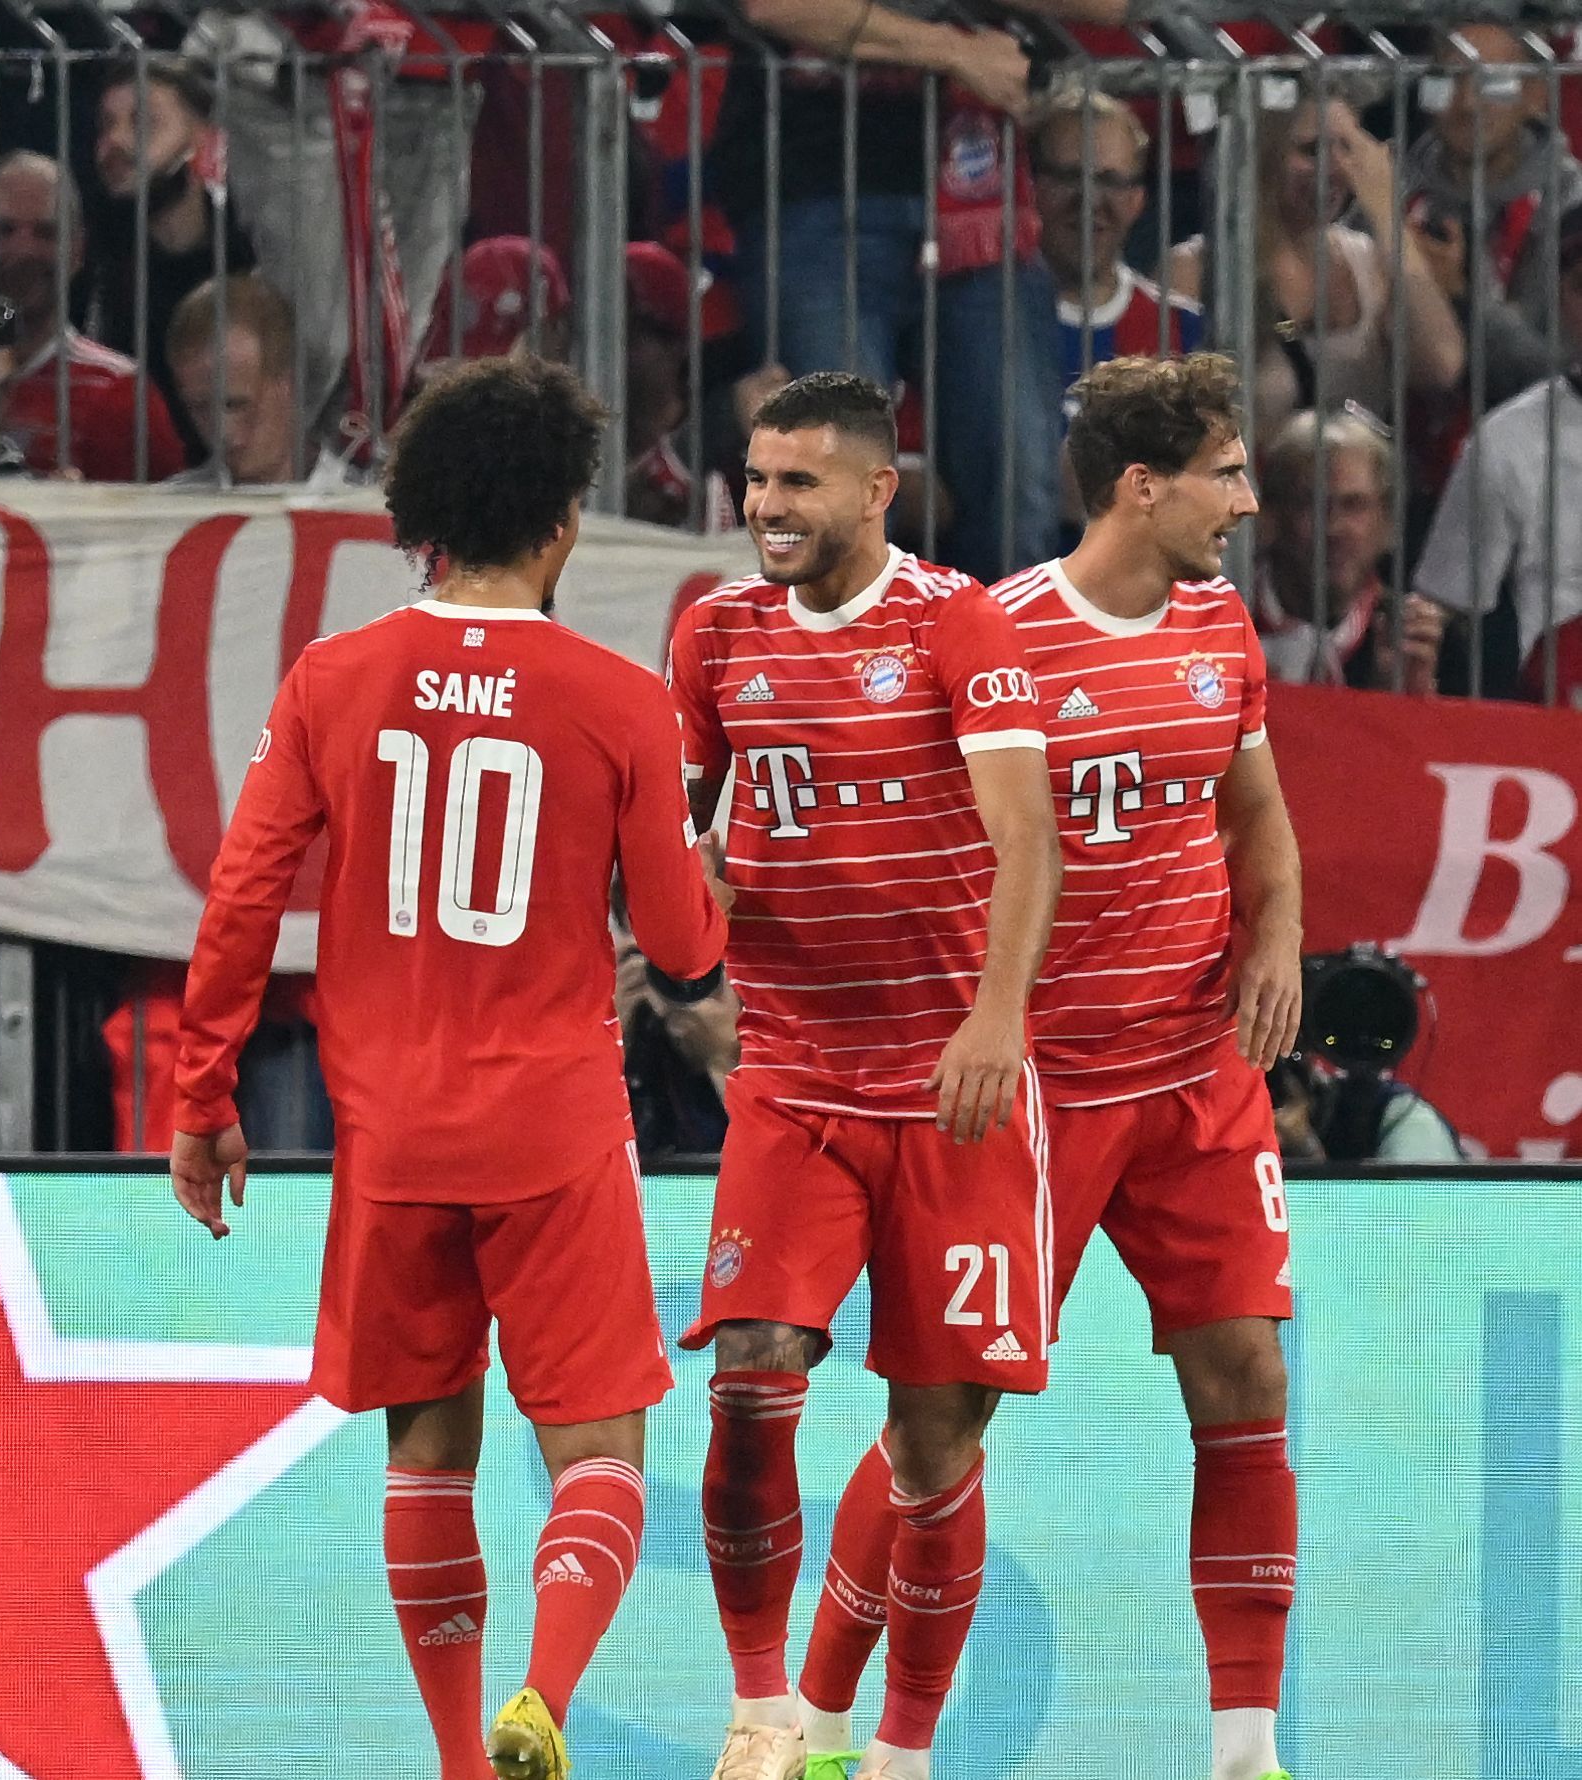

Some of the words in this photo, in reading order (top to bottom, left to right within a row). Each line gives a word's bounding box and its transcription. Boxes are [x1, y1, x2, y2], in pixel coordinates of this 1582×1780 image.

[414, 668, 516, 718] SANÉ
[736, 690, 775, 702] adidas
[1057, 704, 1100, 719] adidas
[376, 729, 543, 947] 10
[1254, 1151, 1289, 1232] 8
[944, 1243, 1010, 1326] 21
[982, 1349, 1028, 1361] adidas
[535, 1569, 595, 1594] adidas
[836, 1578, 888, 1616] BAYER
[418, 1629, 483, 1647] adidas
